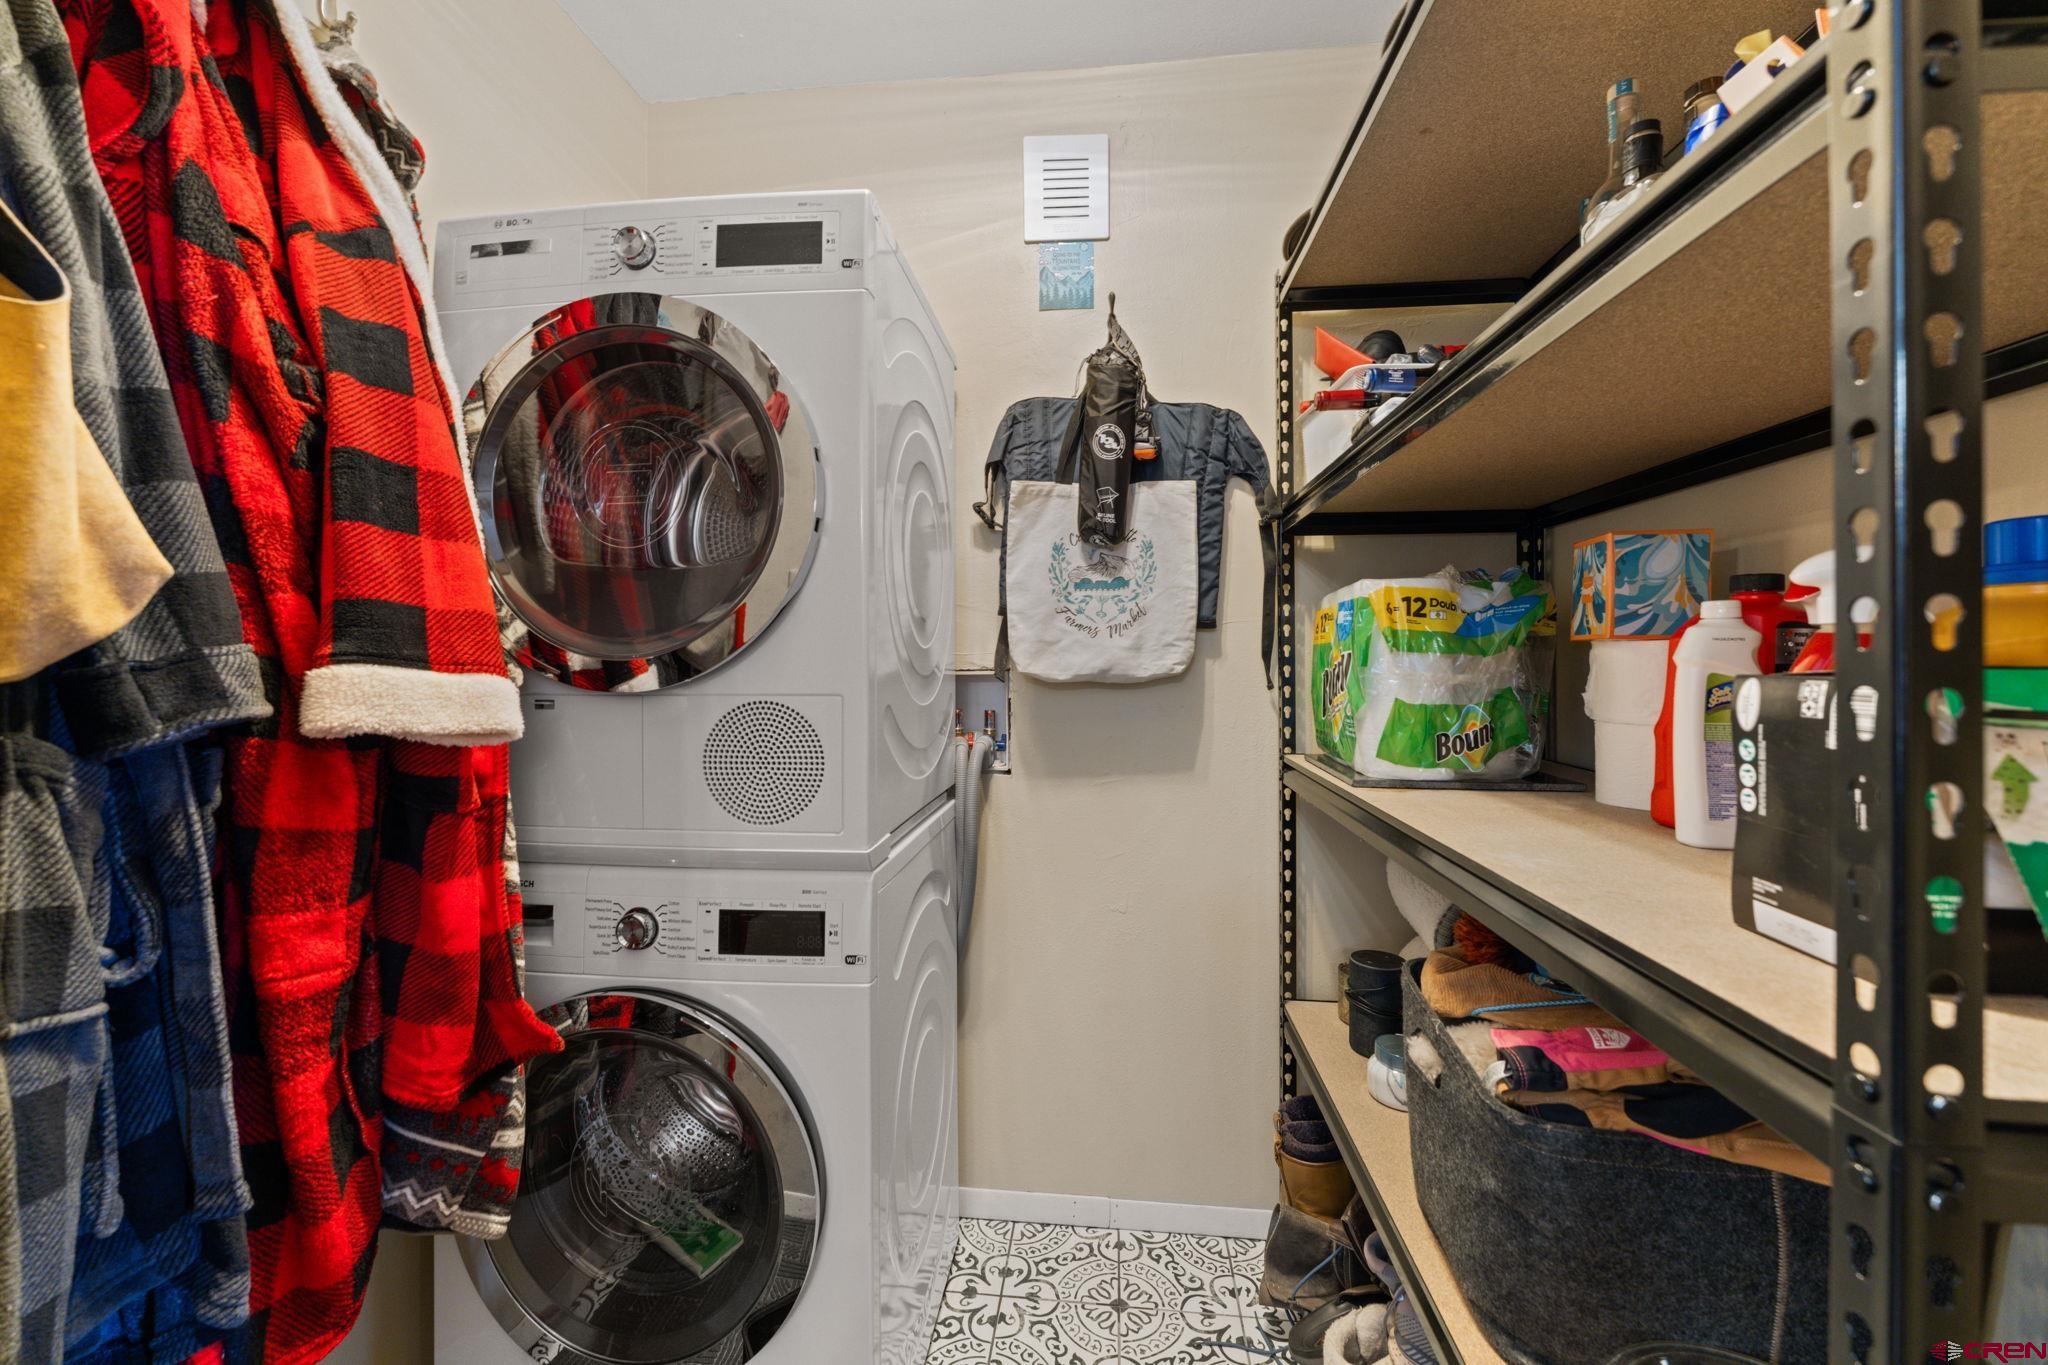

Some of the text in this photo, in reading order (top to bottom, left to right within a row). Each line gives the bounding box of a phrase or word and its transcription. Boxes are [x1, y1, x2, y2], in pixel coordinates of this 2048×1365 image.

[1055, 602, 1147, 638] Farmers Market
[1401, 596, 1427, 618] 12
[1429, 598, 1458, 611] Doub
[1436, 722, 1494, 762] Bount
[845, 955, 866, 965] WiFi
